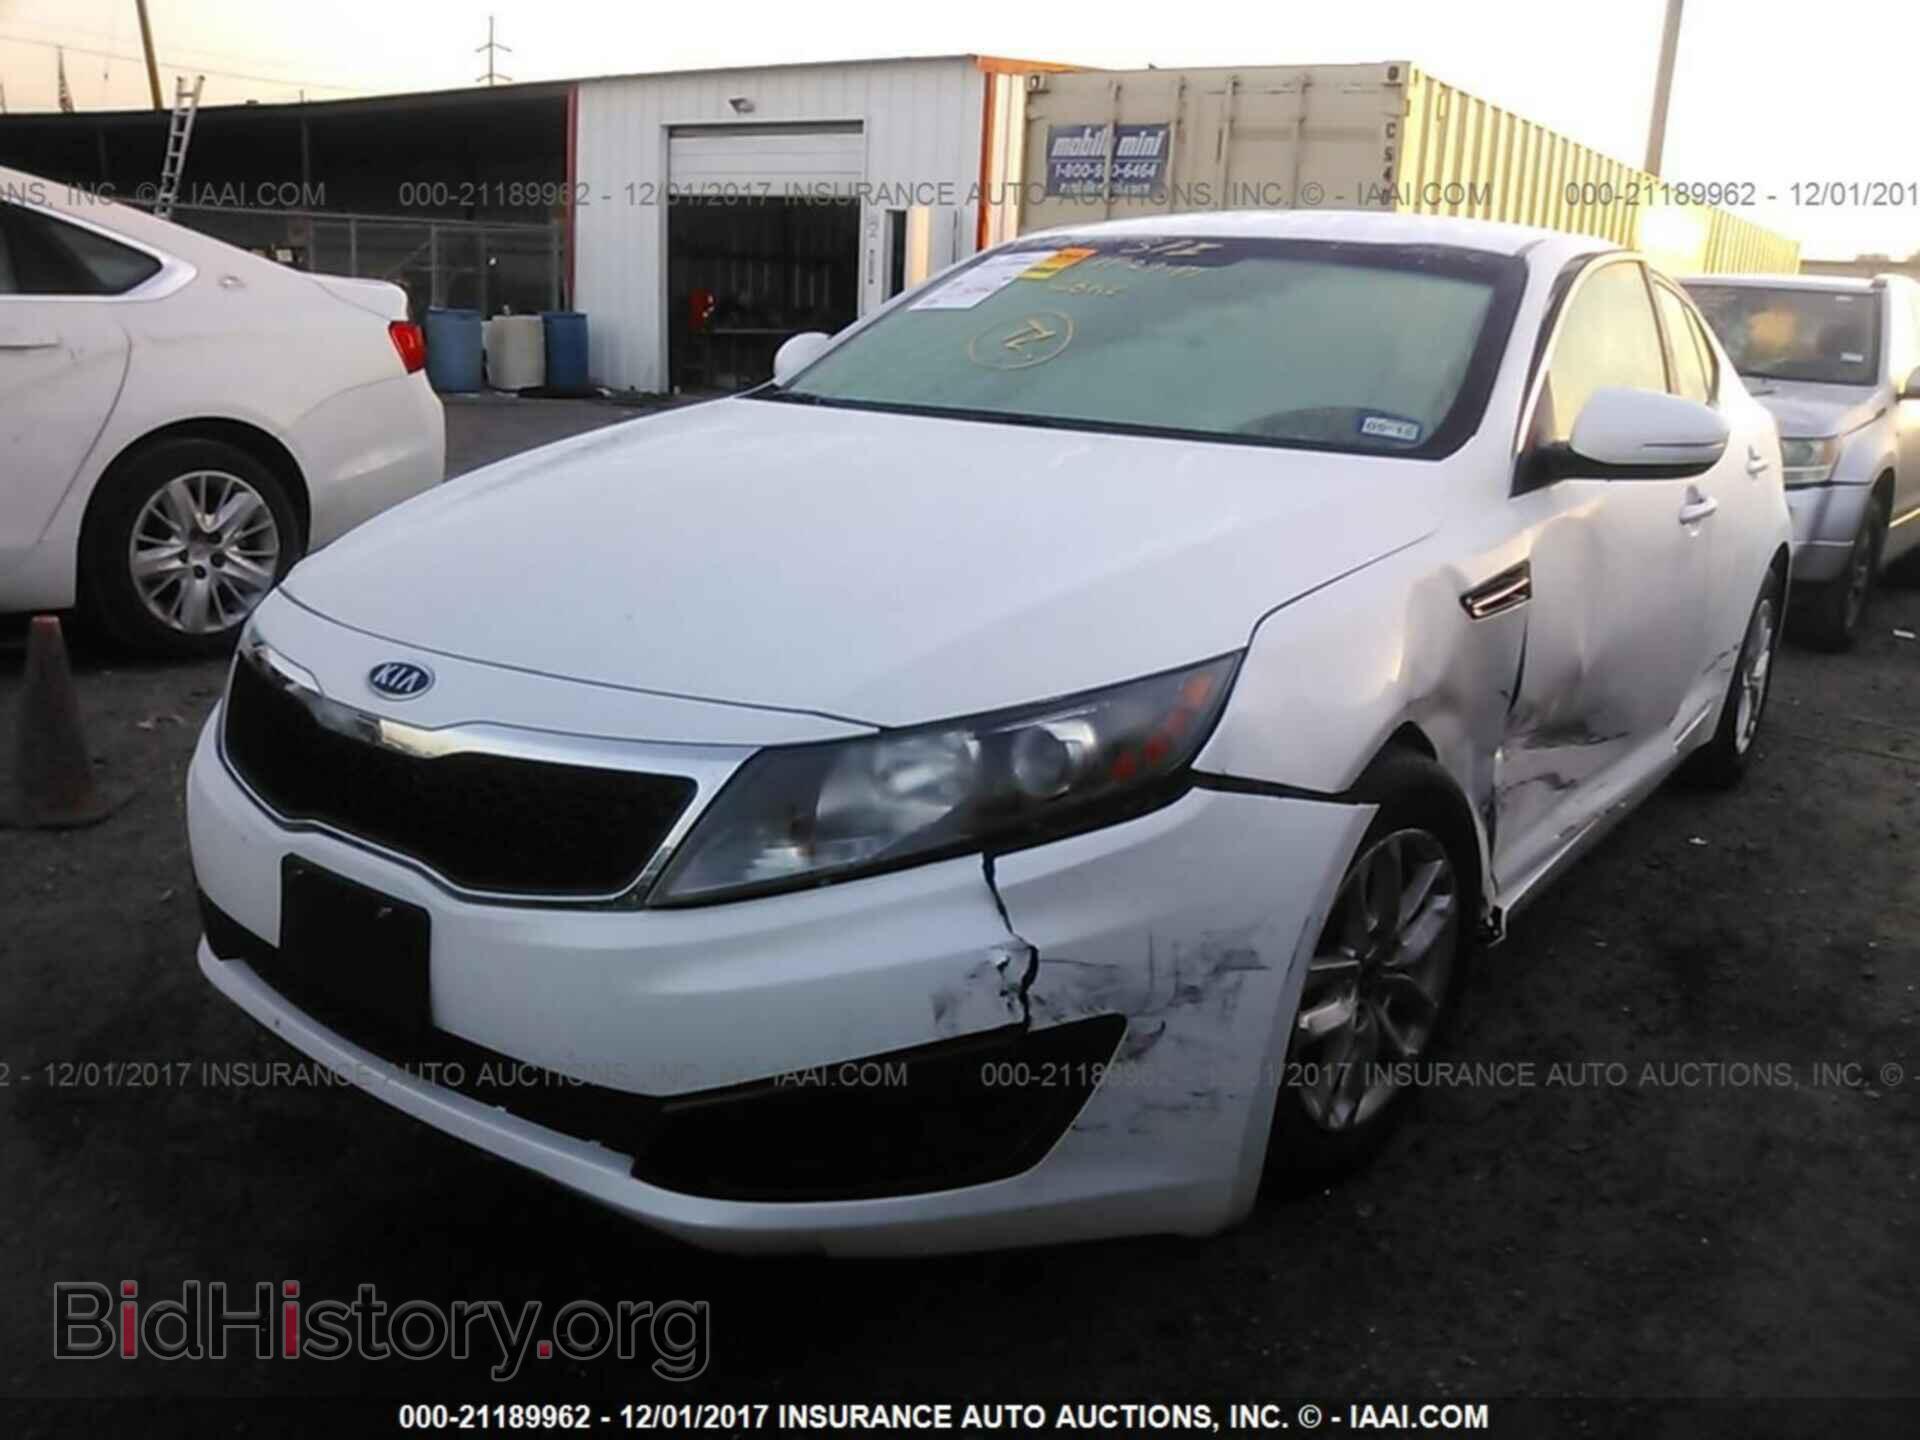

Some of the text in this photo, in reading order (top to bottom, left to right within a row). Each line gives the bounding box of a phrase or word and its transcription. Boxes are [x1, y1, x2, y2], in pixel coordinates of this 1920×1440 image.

[1050, 127, 1165, 157] mobil mini
[1055, 162, 1157, 179] 1-800-90-6464
[374, 663, 420, 692] KIA
